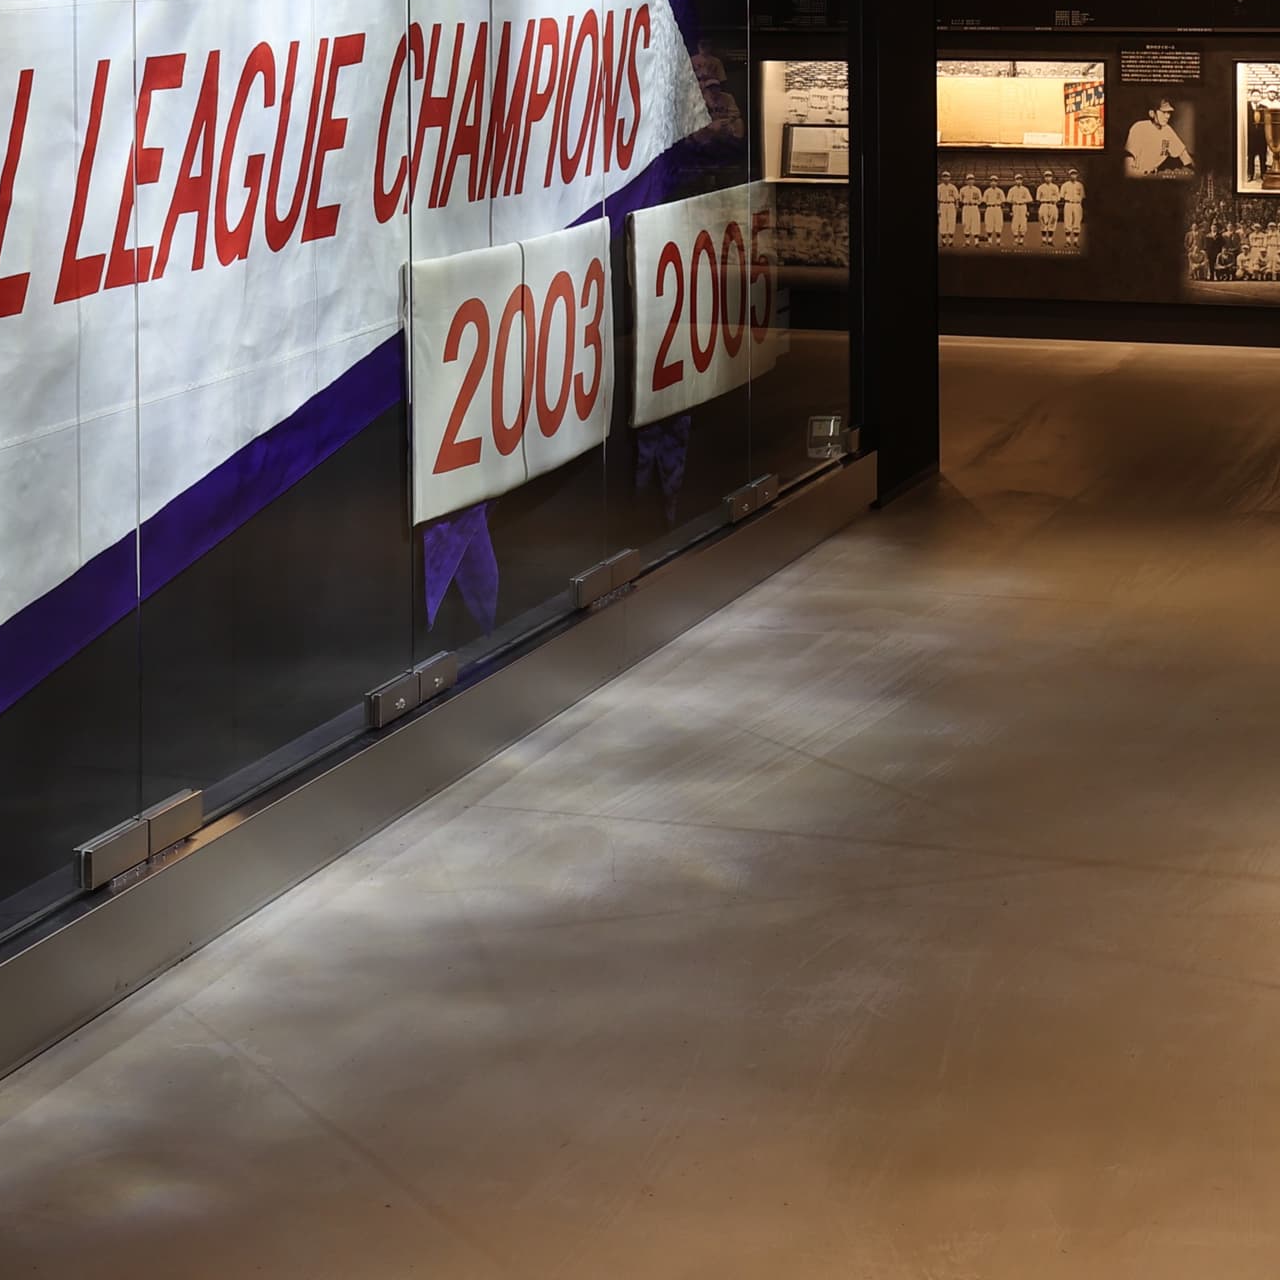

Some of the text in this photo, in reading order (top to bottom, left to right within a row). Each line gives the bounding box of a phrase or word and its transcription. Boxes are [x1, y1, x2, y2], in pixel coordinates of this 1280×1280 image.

[52, 32, 366, 305] LEAGUE
[372, 3, 651, 225] CHAMPIONS
[431, 257, 606, 475] 2003
[651, 210, 773, 393] 2005
